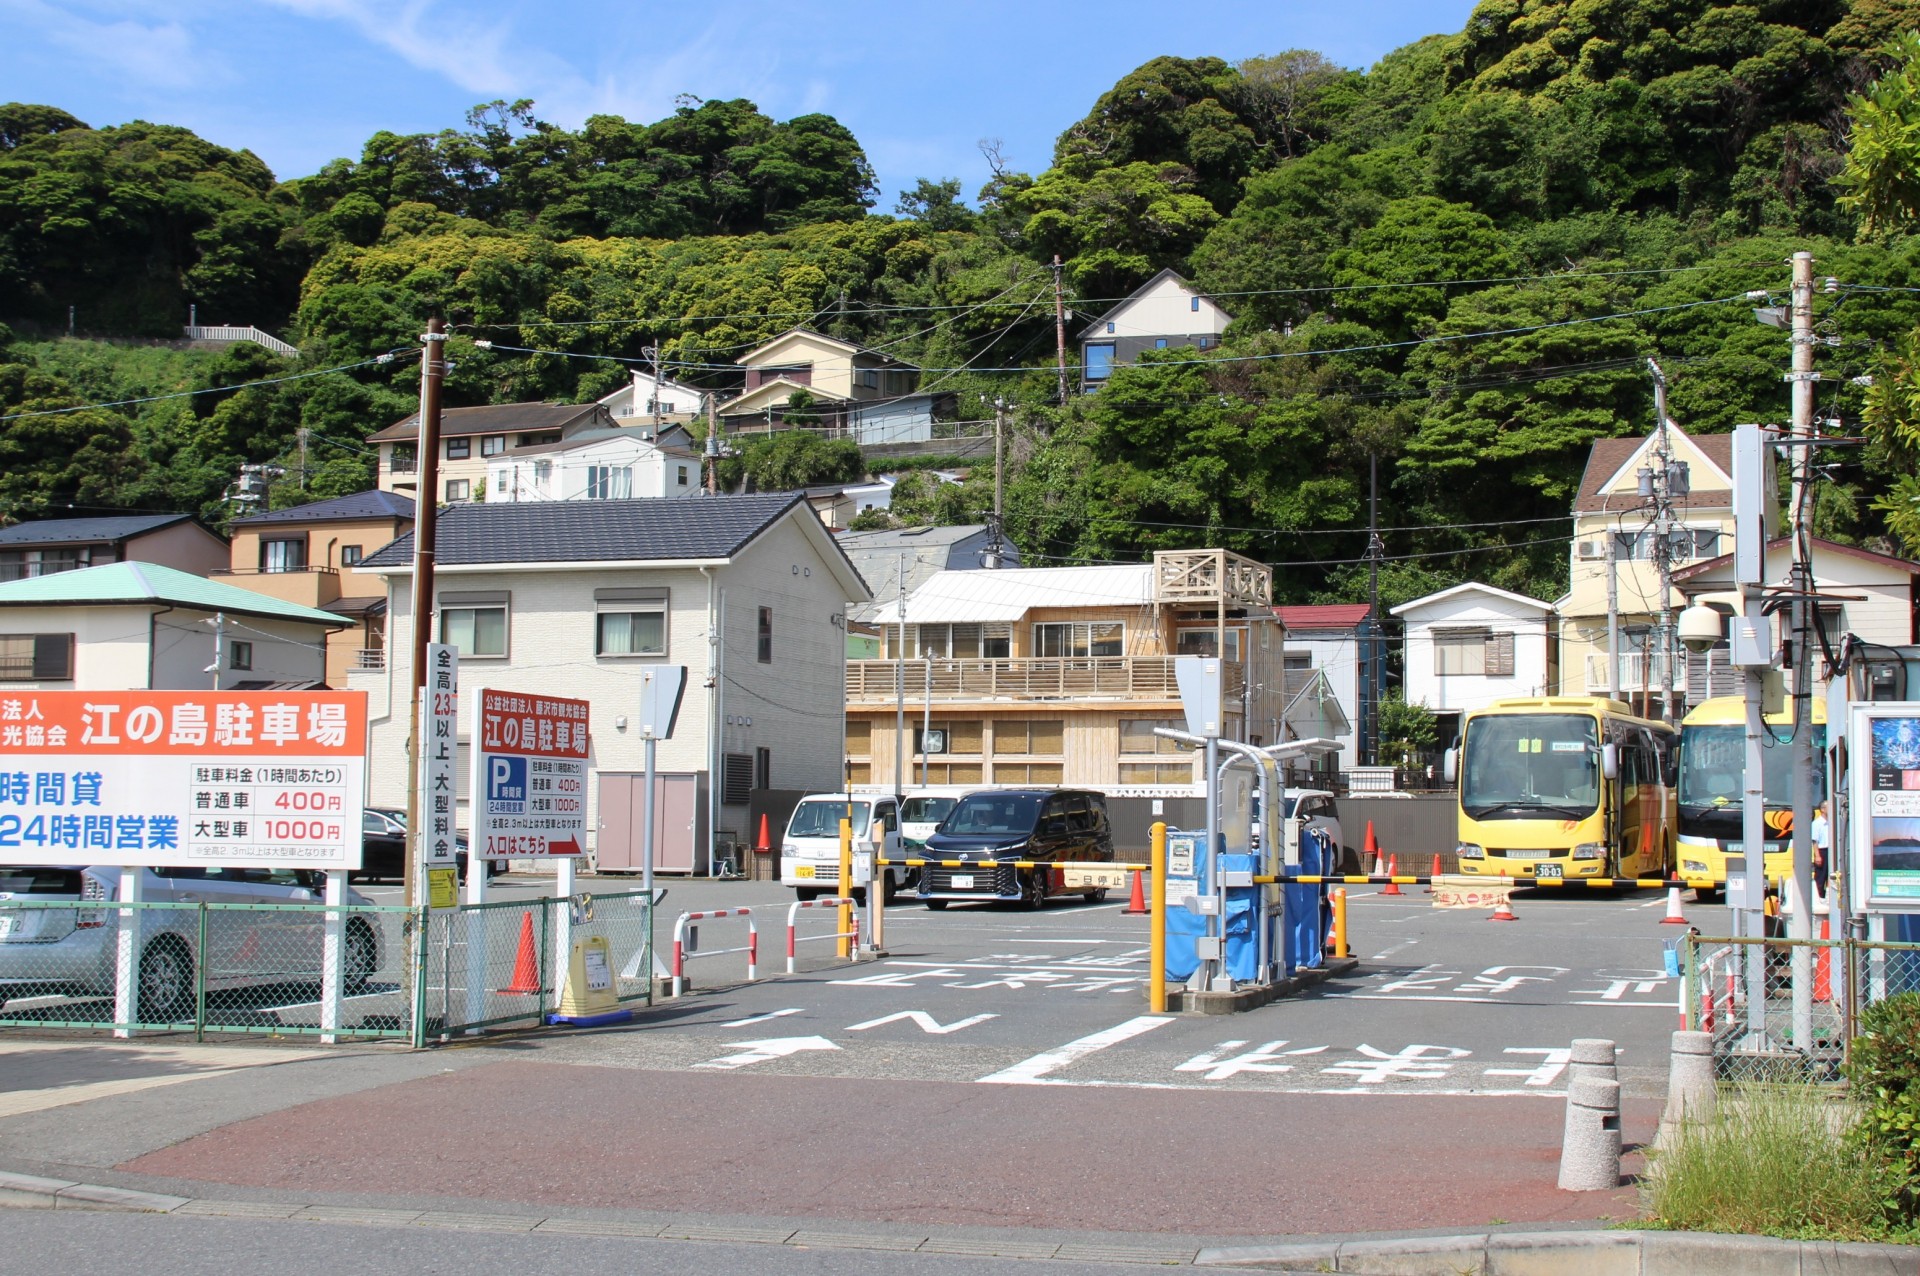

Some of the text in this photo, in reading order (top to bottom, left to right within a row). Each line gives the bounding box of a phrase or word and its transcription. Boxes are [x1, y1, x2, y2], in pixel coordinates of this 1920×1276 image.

[2, 699, 44, 720] 法人
[486, 695, 587, 719] 公益社団法人 藤沢市観光協会
[2, 725, 67, 746] 光協会
[80, 702, 348, 748] 江の島駐車場
[485, 713, 587, 753] 江の島駐車場
[0, 771, 103, 806] 時間貸
[492, 758, 511, 798] P
[532, 778, 580, 792] 普通車 400円
[195, 791, 341, 810] 普通車 400円
[502, 786, 522, 798] 時間貸
[490, 802, 524, 812] 24時間営業
[532, 798, 579, 811] 大型車 1000円
[0, 814, 179, 850] 24時間営業
[195, 820, 340, 839] 大型車 1000円
[486, 835, 546, 855] 入口はこちら
[1068, 875, 1122, 886] 一旦停止
[721, 1008, 1001, 1034] IN
